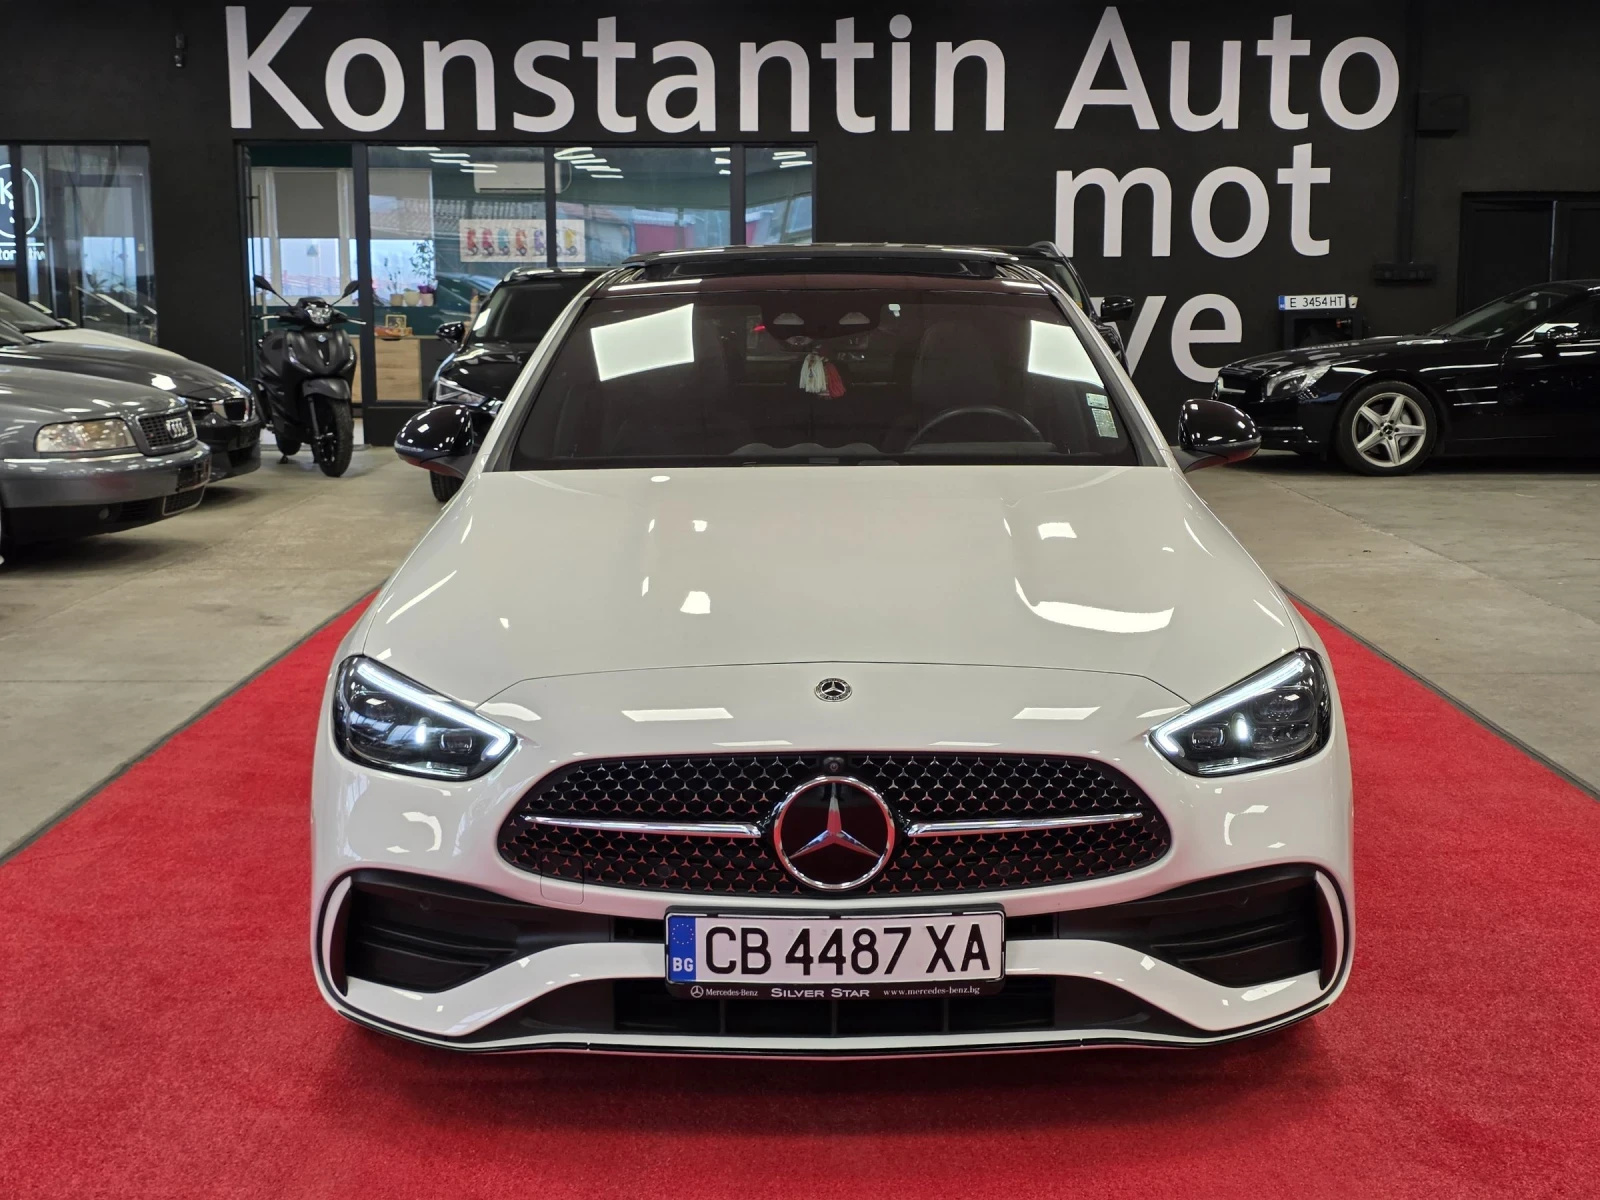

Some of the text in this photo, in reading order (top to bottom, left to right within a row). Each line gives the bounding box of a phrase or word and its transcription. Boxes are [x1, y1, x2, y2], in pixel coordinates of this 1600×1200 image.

[226, 6, 1400, 134] Konstantin Auto
[1055, 143, 1331, 259] mot
[1290, 296, 1344, 308] E 3454 HT
[1090, 293, 1243, 383] ve
[672, 957, 694, 972] BG
[705, 923, 991, 976] CB 4487 XA
[705, 988, 759, 997] Mercedes-Benz
[882, 985, 981, 996] www.mercedes-benz.bg
